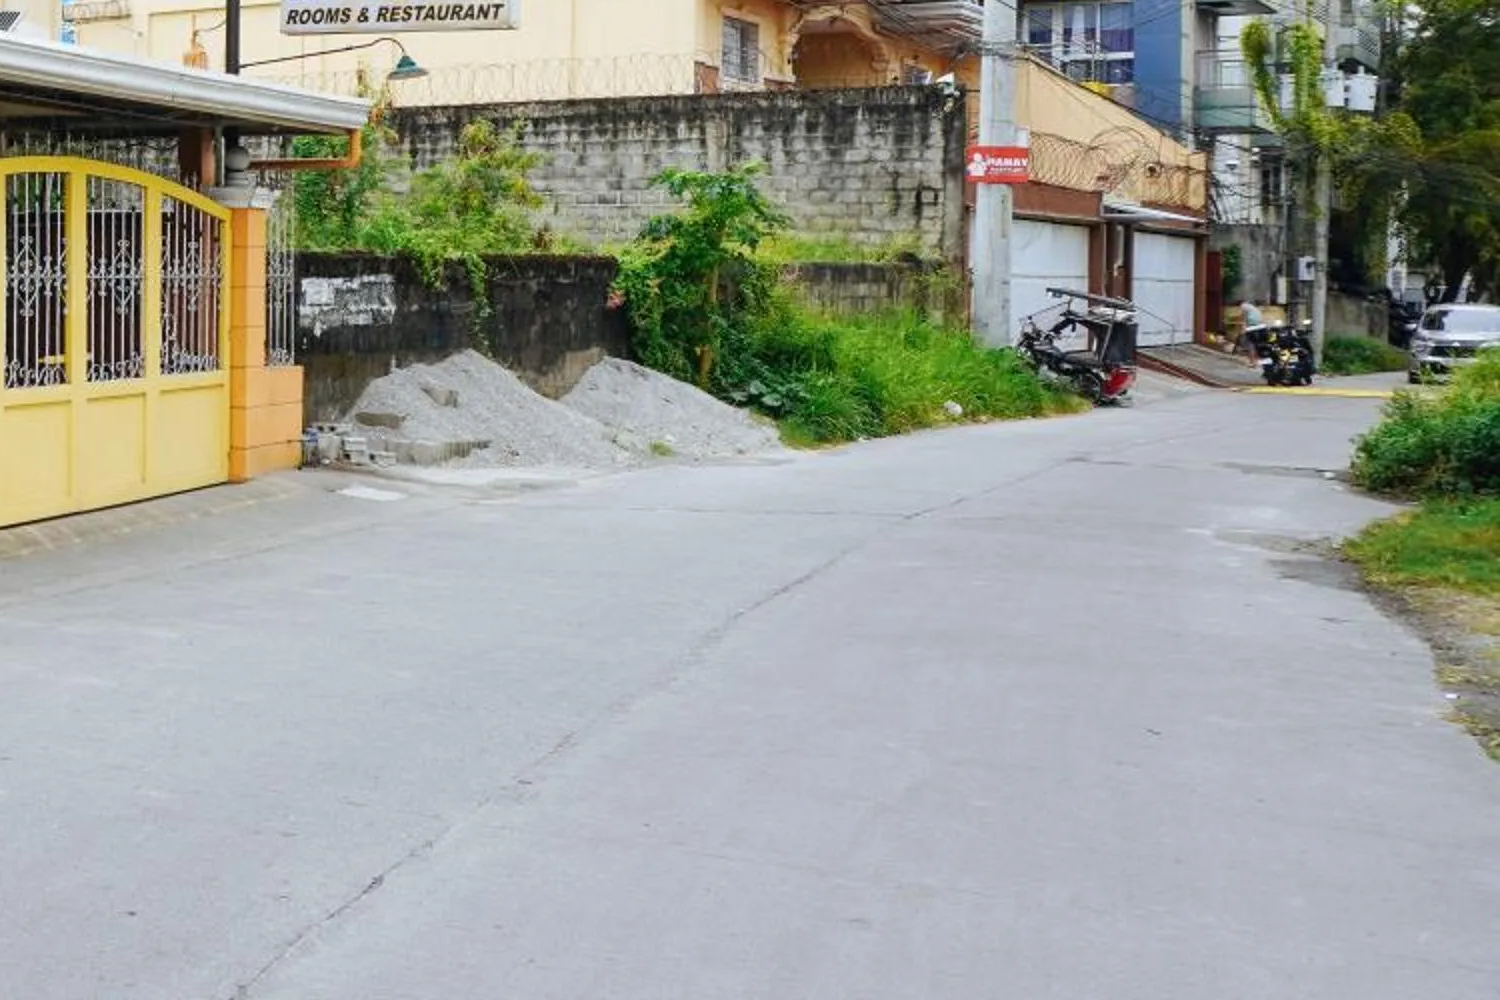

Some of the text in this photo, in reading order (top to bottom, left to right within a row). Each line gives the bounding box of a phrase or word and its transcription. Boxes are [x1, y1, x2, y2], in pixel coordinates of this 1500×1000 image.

[286, 3, 505, 25] ROOMS & RESTAURANT
